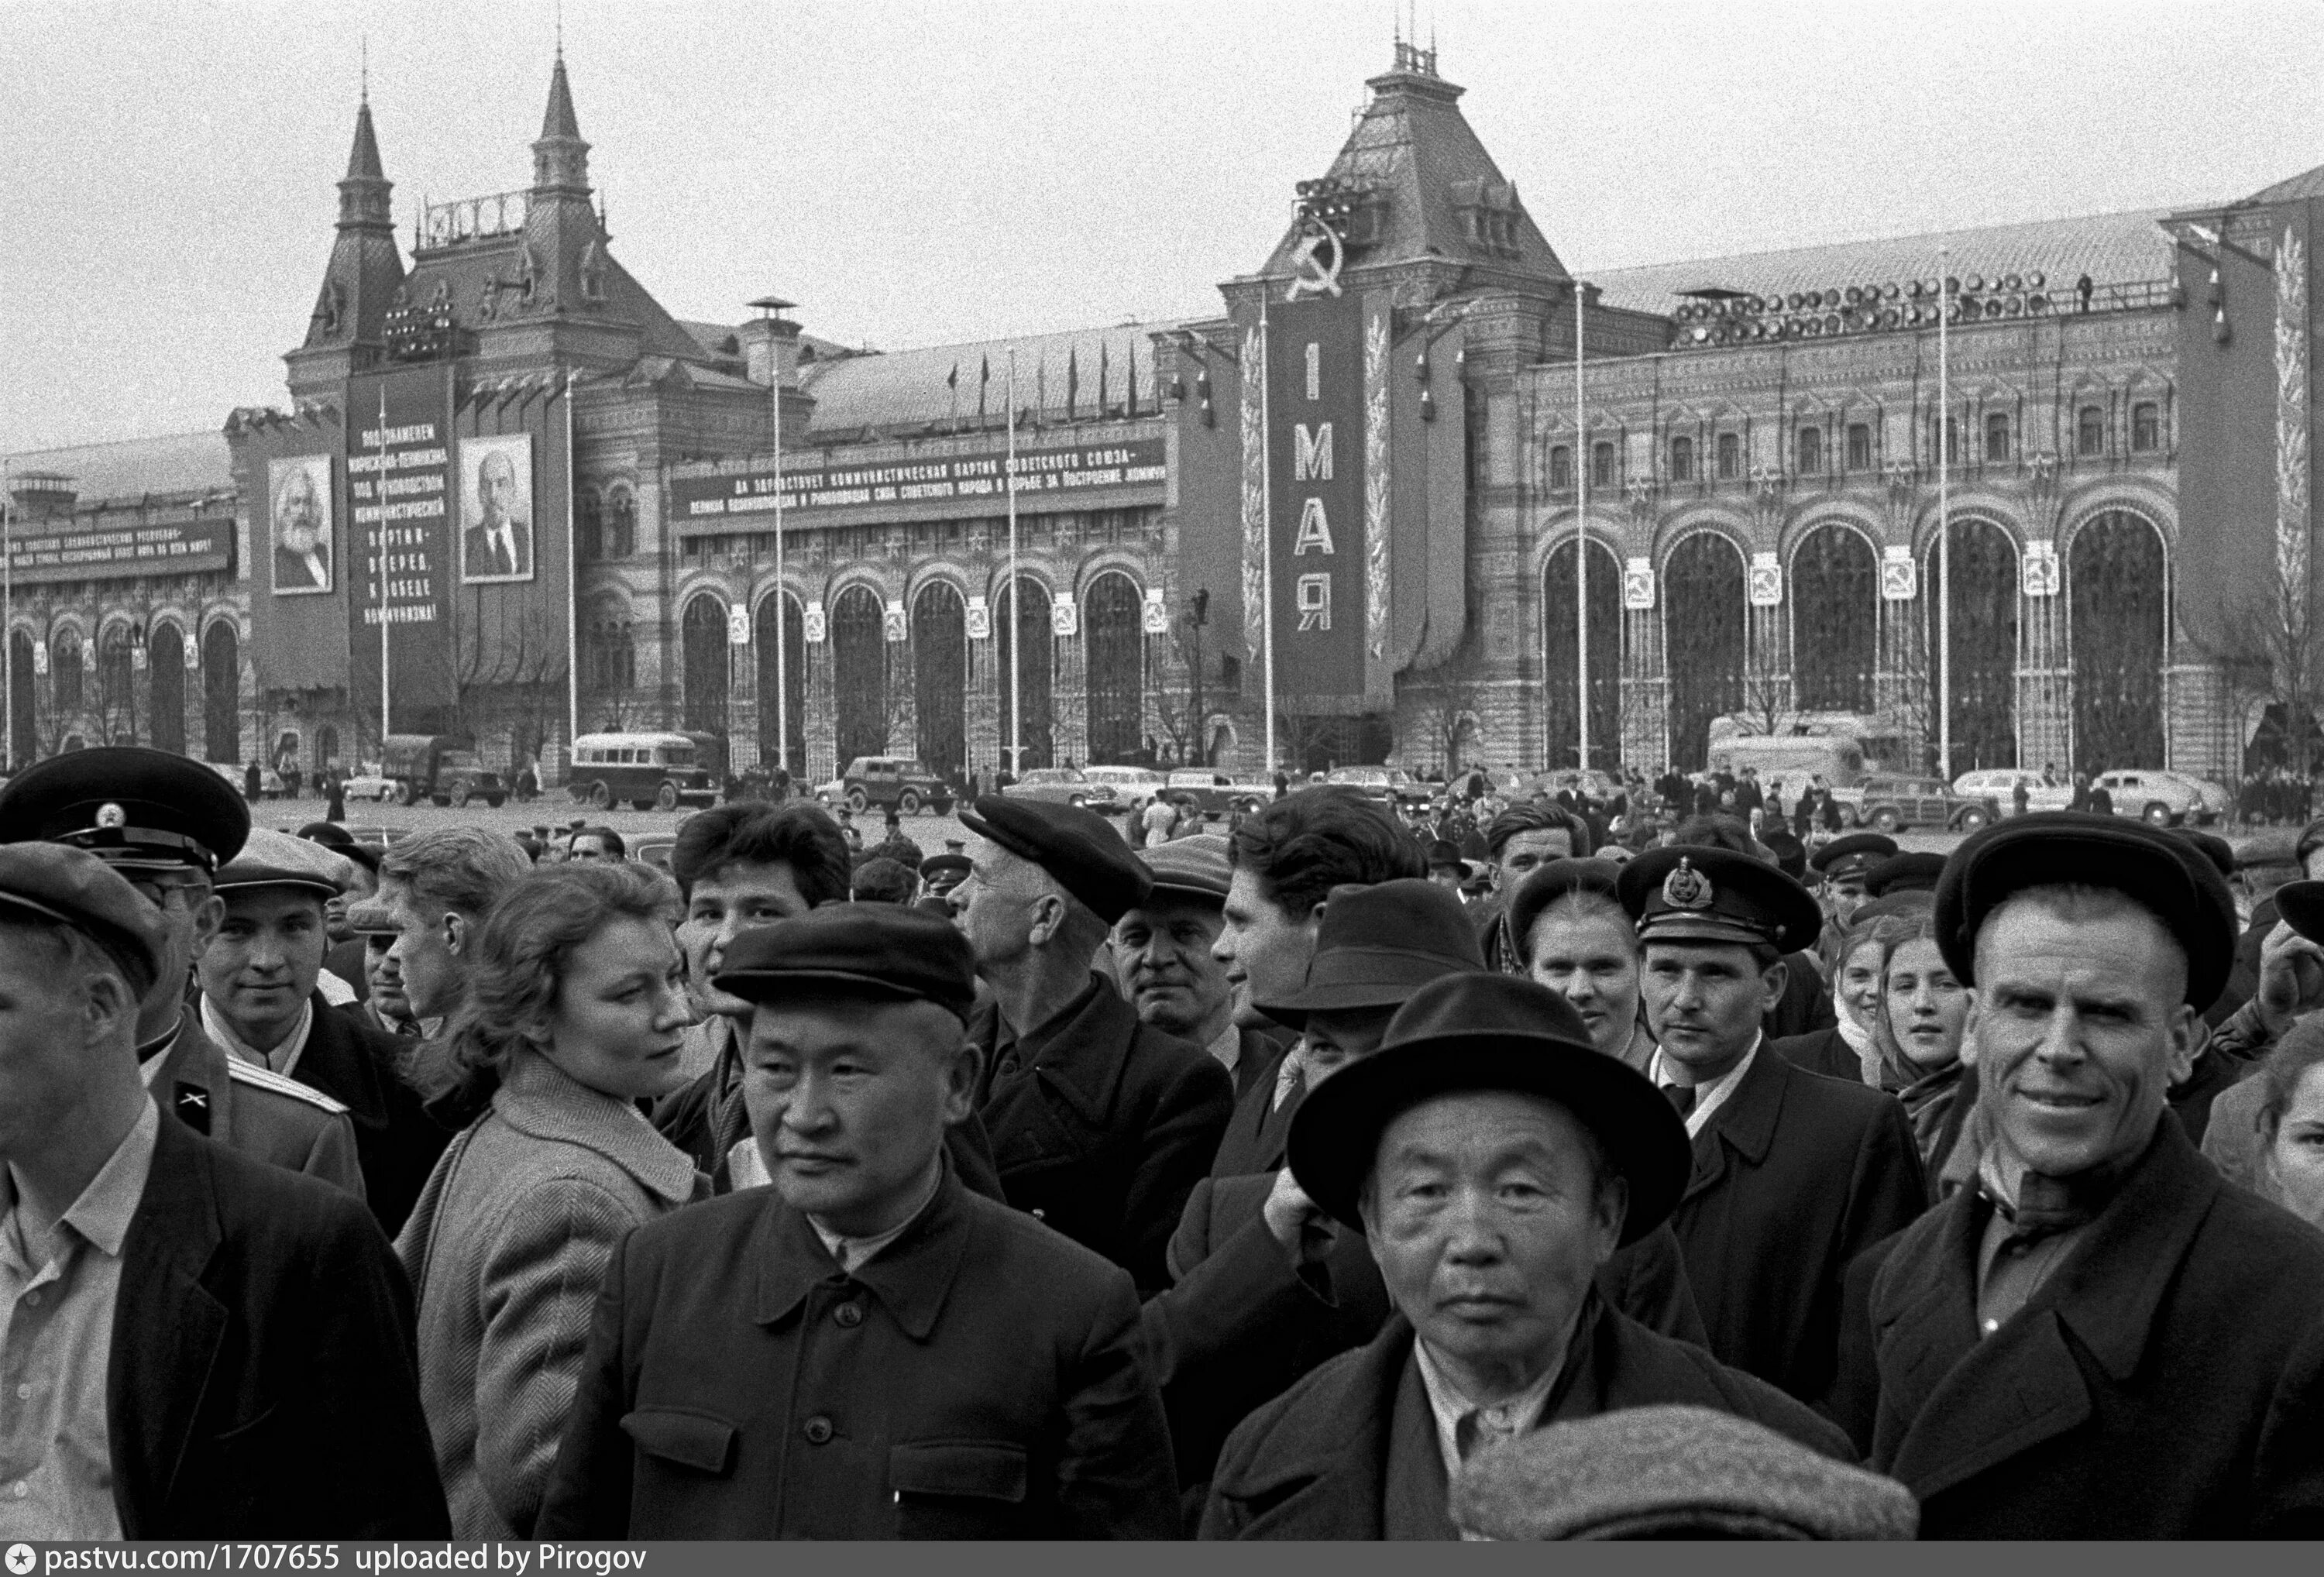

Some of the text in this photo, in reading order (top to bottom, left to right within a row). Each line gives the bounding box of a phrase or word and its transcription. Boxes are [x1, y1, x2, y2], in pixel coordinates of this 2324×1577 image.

[376, 473, 445, 495] РКОВОДСТВОМ
[735, 479, 749, 495] ДА
[830, 463, 947, 486] КОММУНИСТИЧЕСКАЯ
[953, 459, 998, 477] ПАРТИЯ
[1005, 452, 1079, 473] СОВЕТСКОГО
[1086, 448, 1136, 467] СОЮЗА-
[900, 482, 954, 500] СОВЕТСКОГО
[1007, 475, 1042, 491] ОРЬБЕ
[1046, 473, 1059, 489] ЗА
[1294, 422, 1335, 632] МАЯ
[382, 578, 431, 598] ОБЕДЕ
